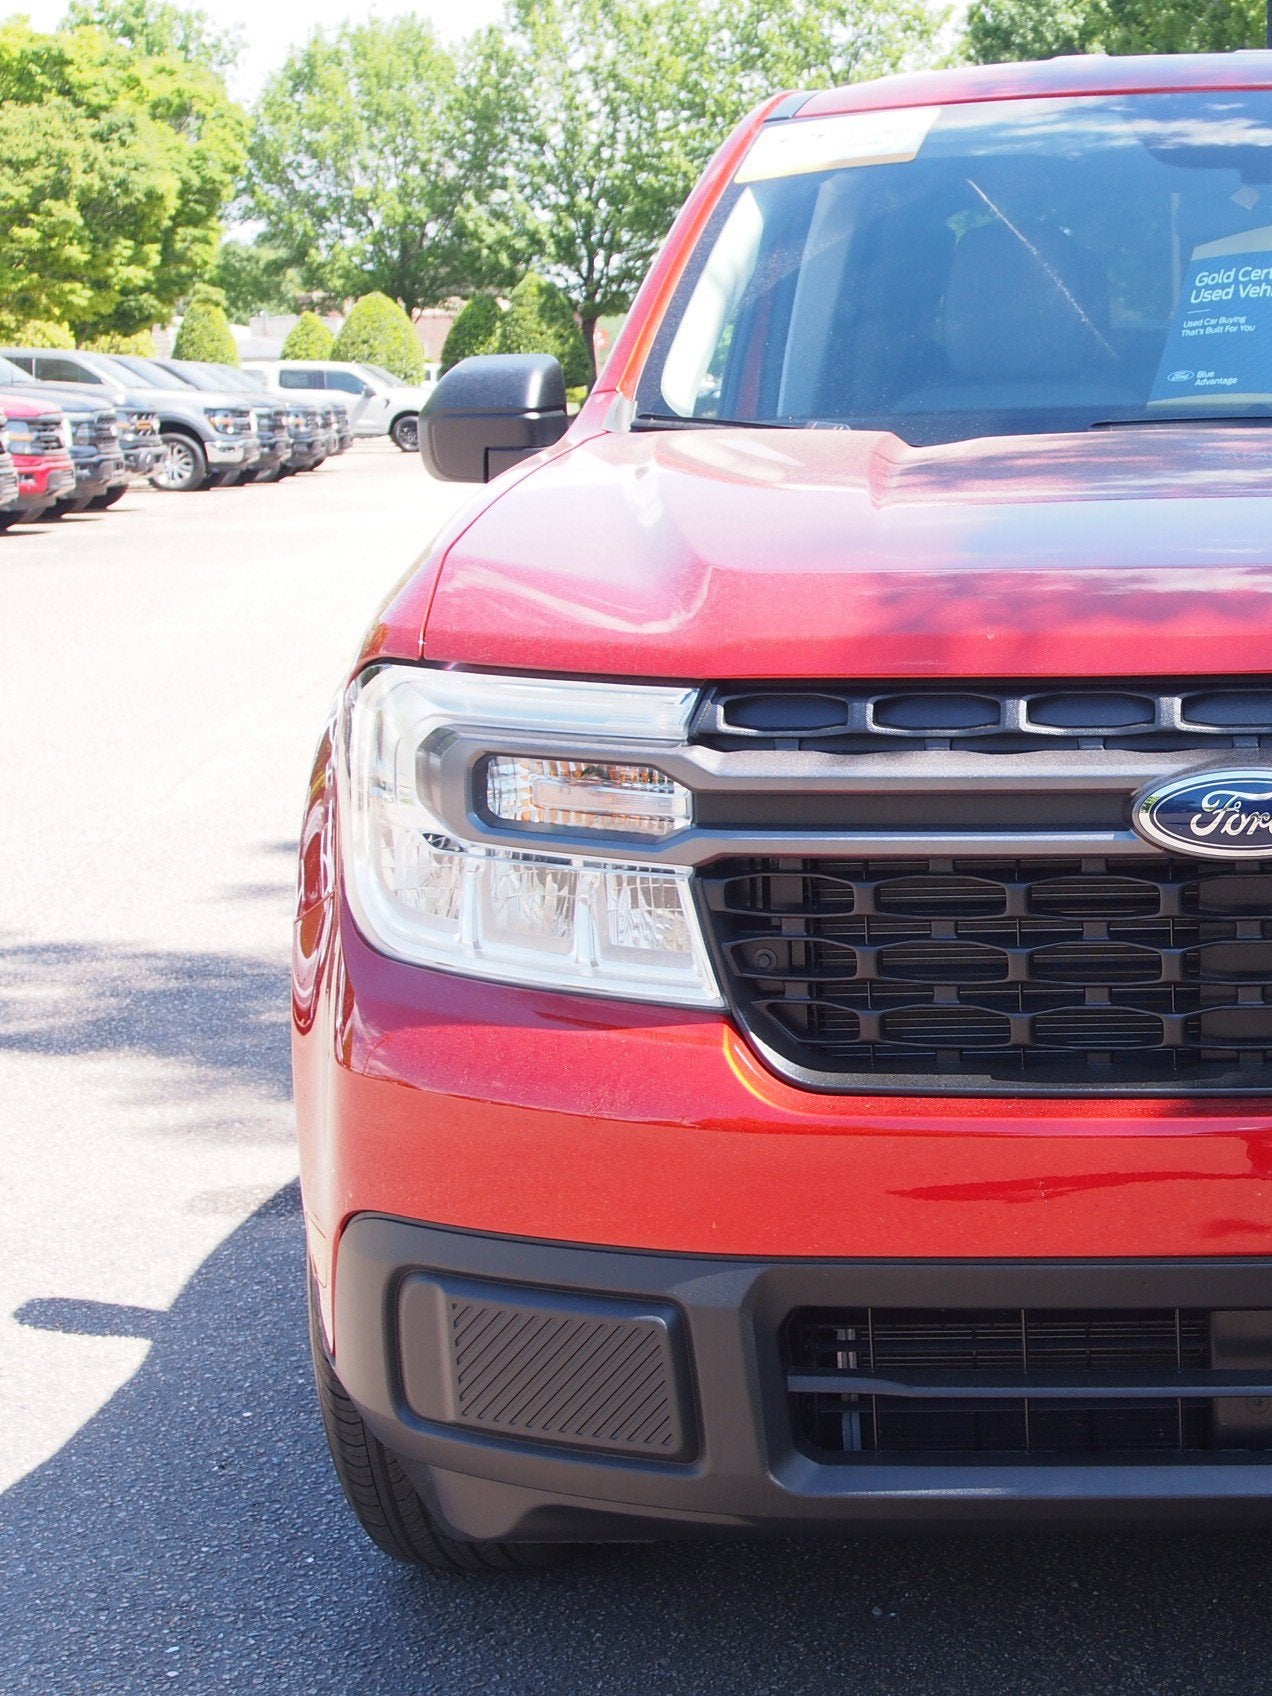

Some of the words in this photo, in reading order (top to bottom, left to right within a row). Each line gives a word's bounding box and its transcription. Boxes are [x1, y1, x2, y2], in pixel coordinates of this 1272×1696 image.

[1195, 268, 1236, 286] Gold
[1190, 284, 1235, 304] Used
[1183, 319, 1204, 328] Used
[1204, 317, 1218, 326] Car
[1219, 315, 1247, 325] Buying
[1181, 328, 1205, 337] That's
[1205, 325, 1224, 335] Built
[1225, 325, 1239, 333] For
[1240, 323, 1256, 332] You
[1196, 370, 1215, 378] Blue
[1194, 377, 1238, 386] Advantage
